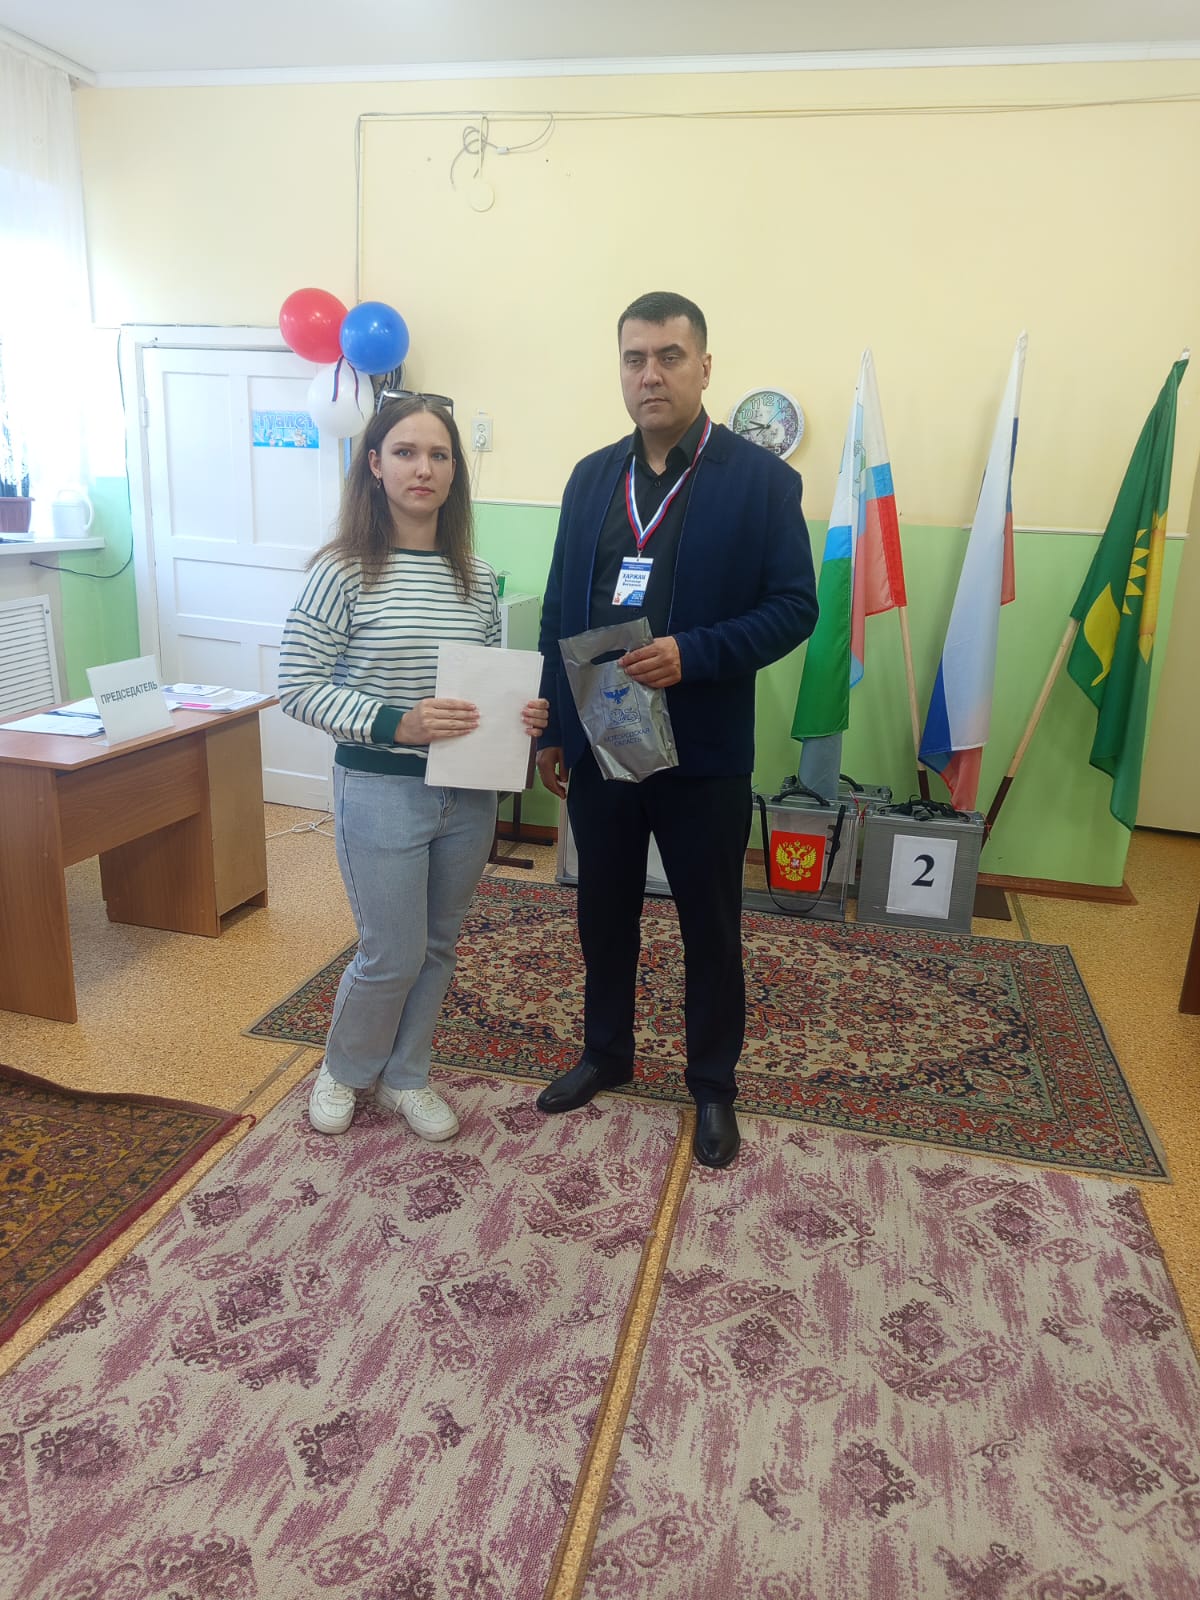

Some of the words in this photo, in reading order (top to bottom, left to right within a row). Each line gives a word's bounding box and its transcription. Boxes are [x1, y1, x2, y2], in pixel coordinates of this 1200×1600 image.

[751, 399, 760, 409] 11
[762, 395, 774, 406] 12
[101, 682, 157, 704] ПРЕДСЕДАТЕЛЬ
[911, 854, 935, 887] 2
